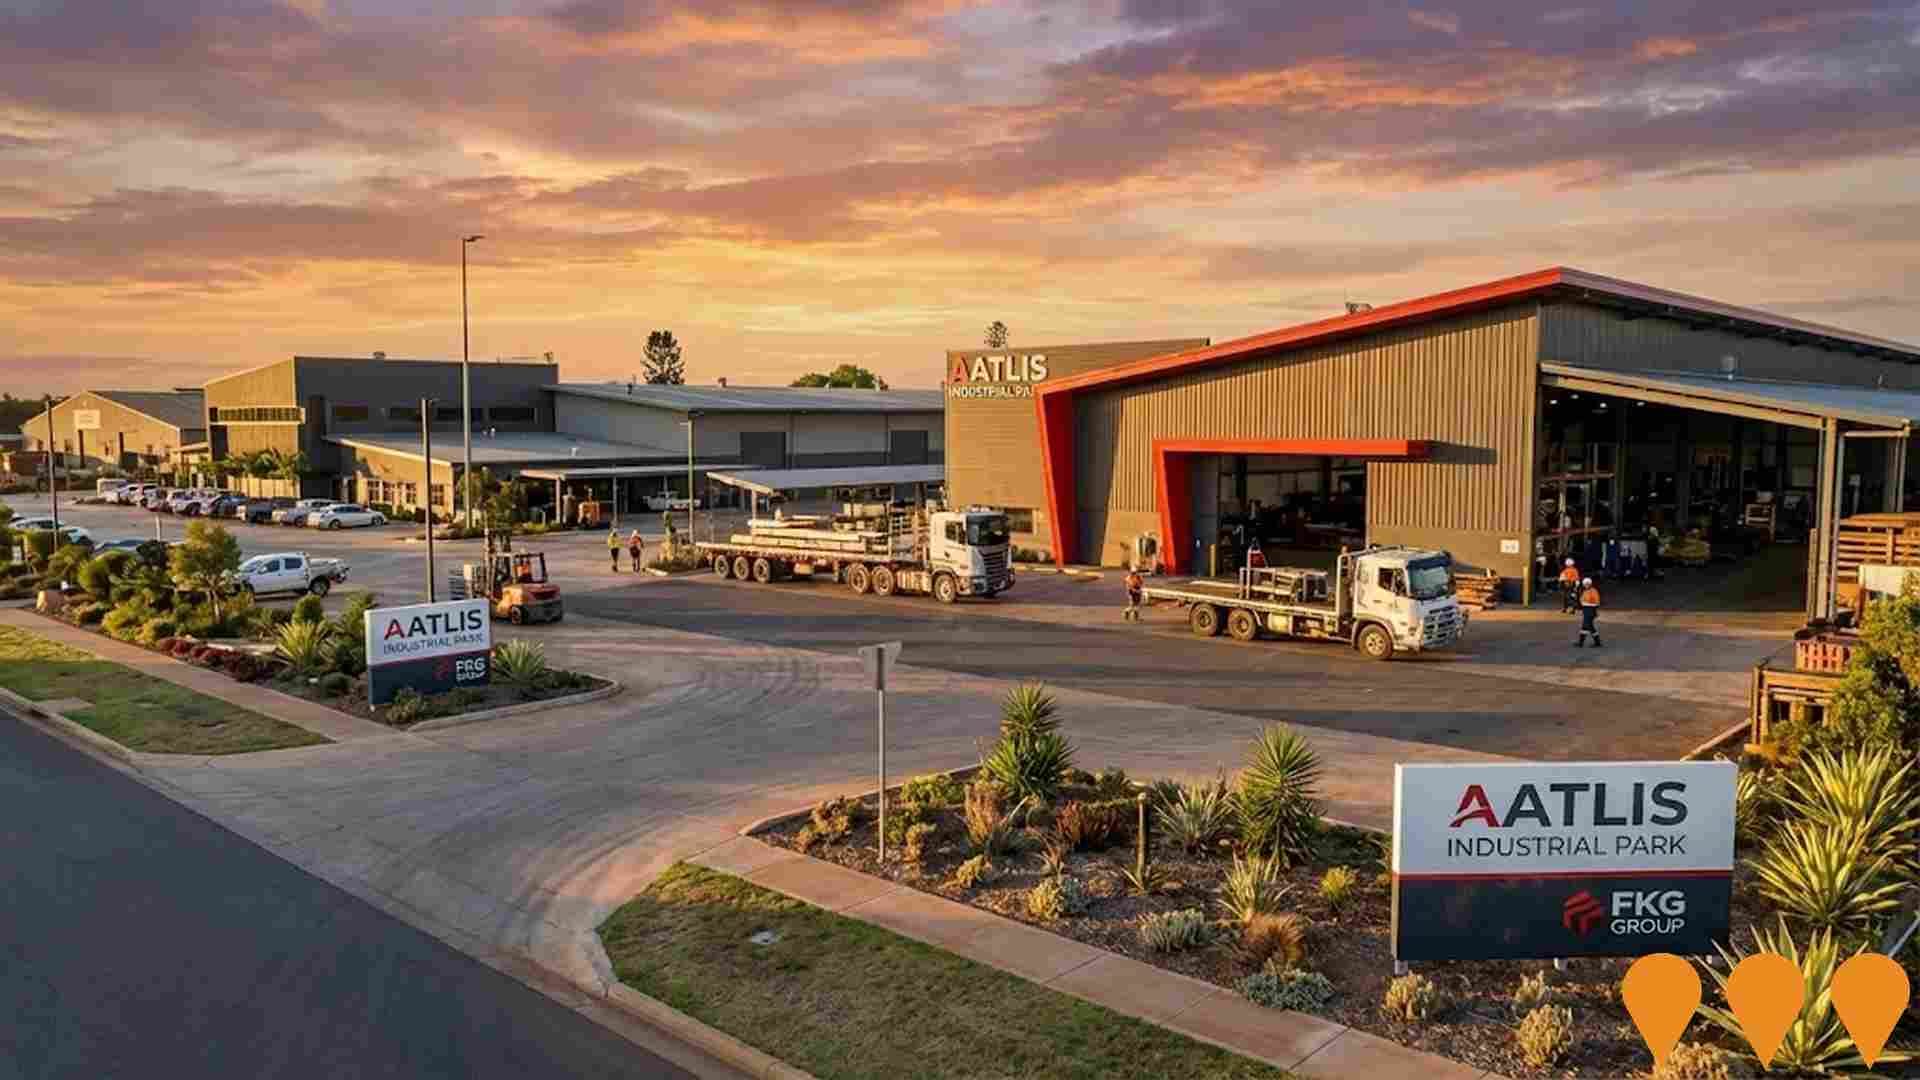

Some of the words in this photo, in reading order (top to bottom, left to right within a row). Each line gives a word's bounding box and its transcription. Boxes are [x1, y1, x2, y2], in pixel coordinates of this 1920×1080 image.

[949, 353, 1048, 384] AATLIS
[383, 608, 483, 640] AATLIS
[1449, 781, 1689, 828] AATLIS
[1447, 835, 1608, 857] INDUSTRIAL
[1615, 834, 1688, 856] PARK
[1611, 890, 1686, 917] FKG
[1610, 918, 1685, 935] GROUP
